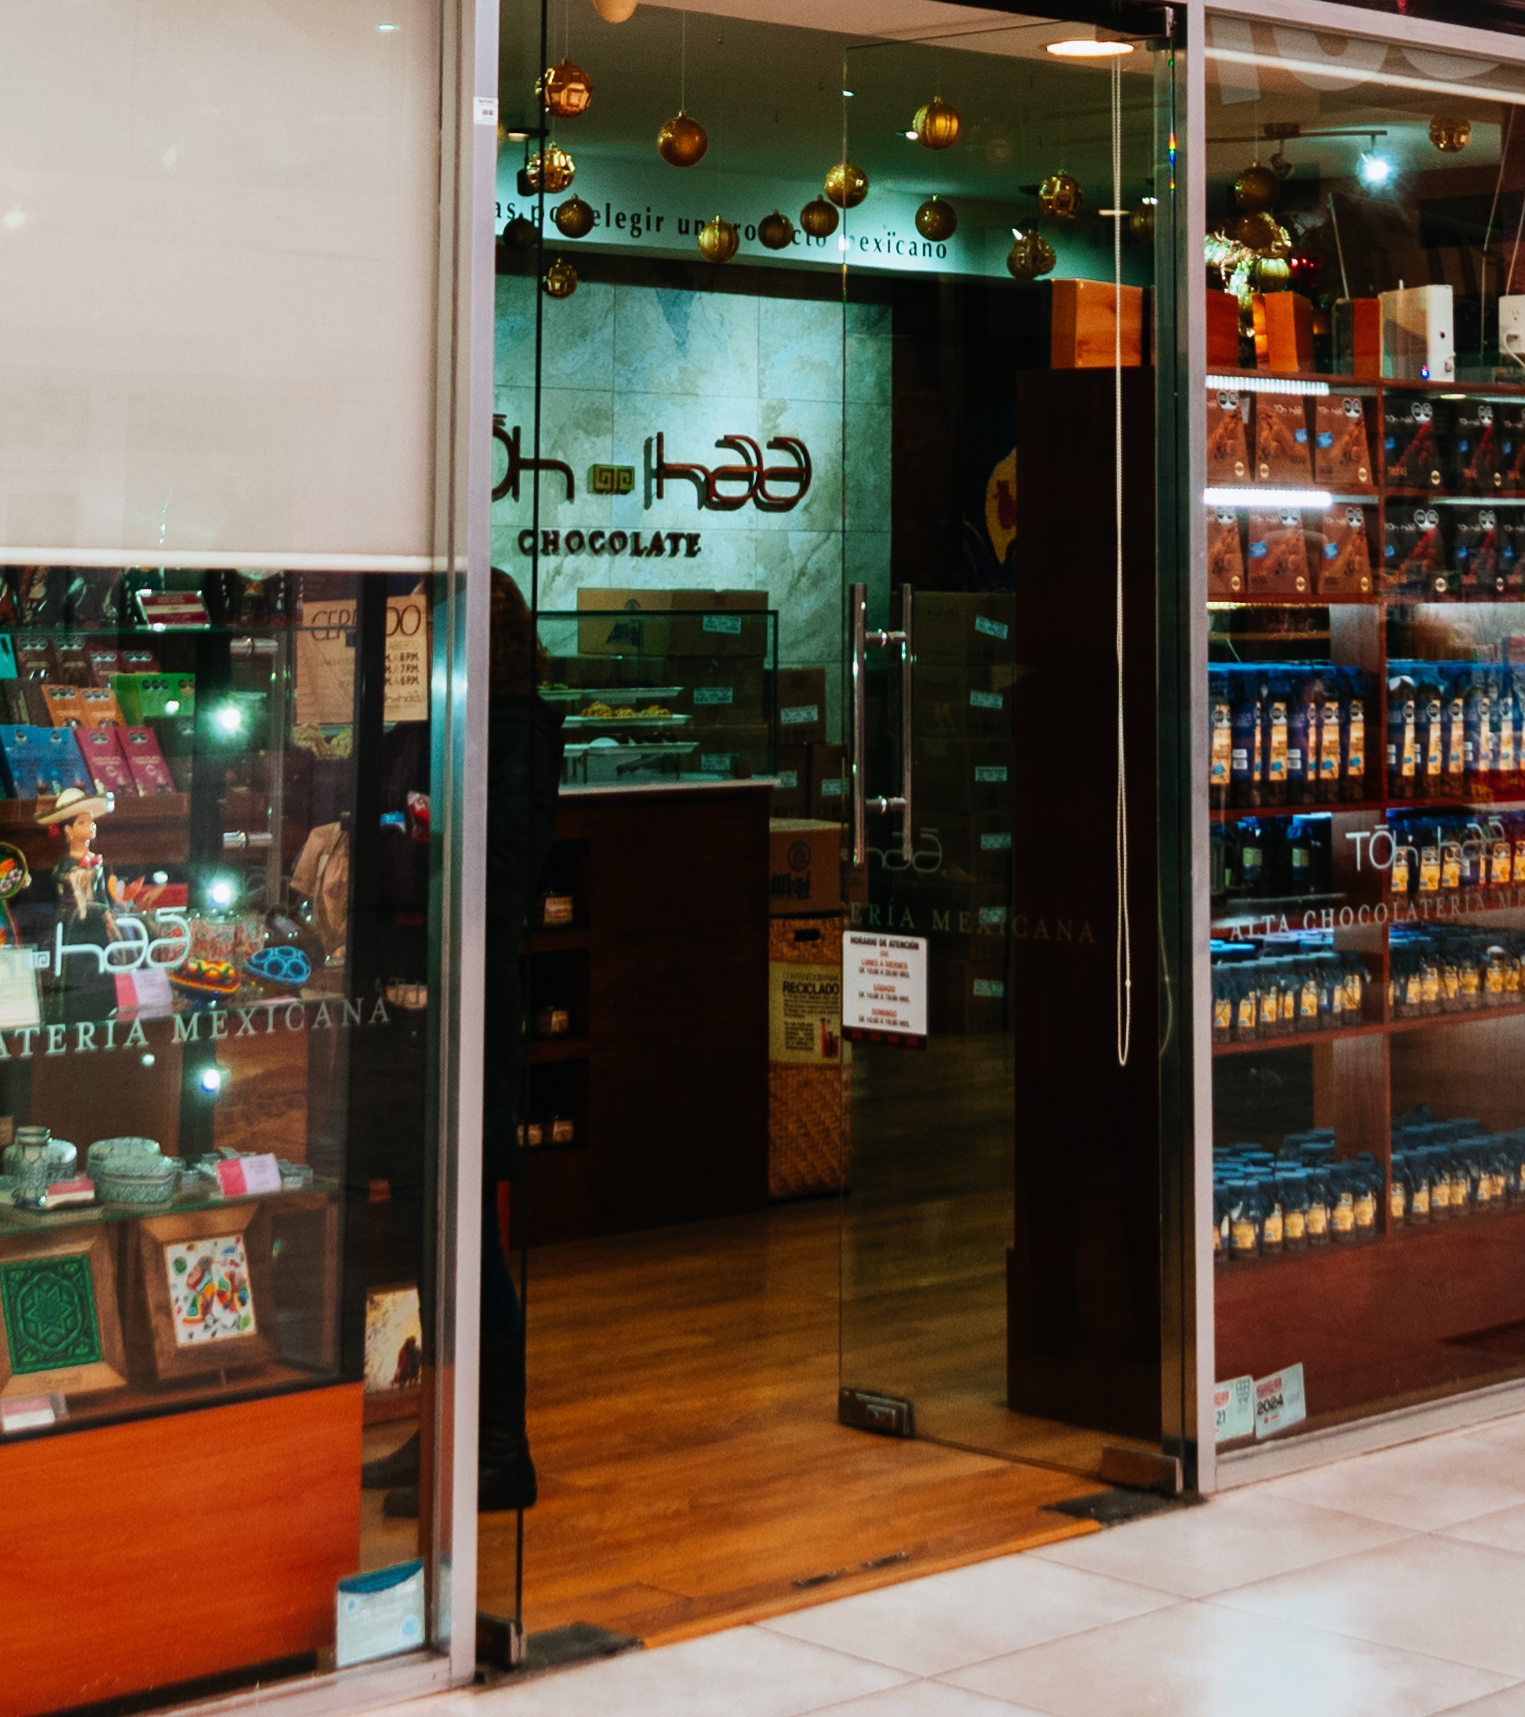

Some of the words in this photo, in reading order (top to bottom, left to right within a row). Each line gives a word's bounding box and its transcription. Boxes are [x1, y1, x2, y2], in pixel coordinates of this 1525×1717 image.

[518, 530, 702, 558] CHOCOLATE
[931, 909, 1096, 945] MEXICANA
[1230, 913, 1290, 940] ALTA
[783, 981, 839, 995] RECICLADO
[172, 997, 392, 1043] MEXICANA
